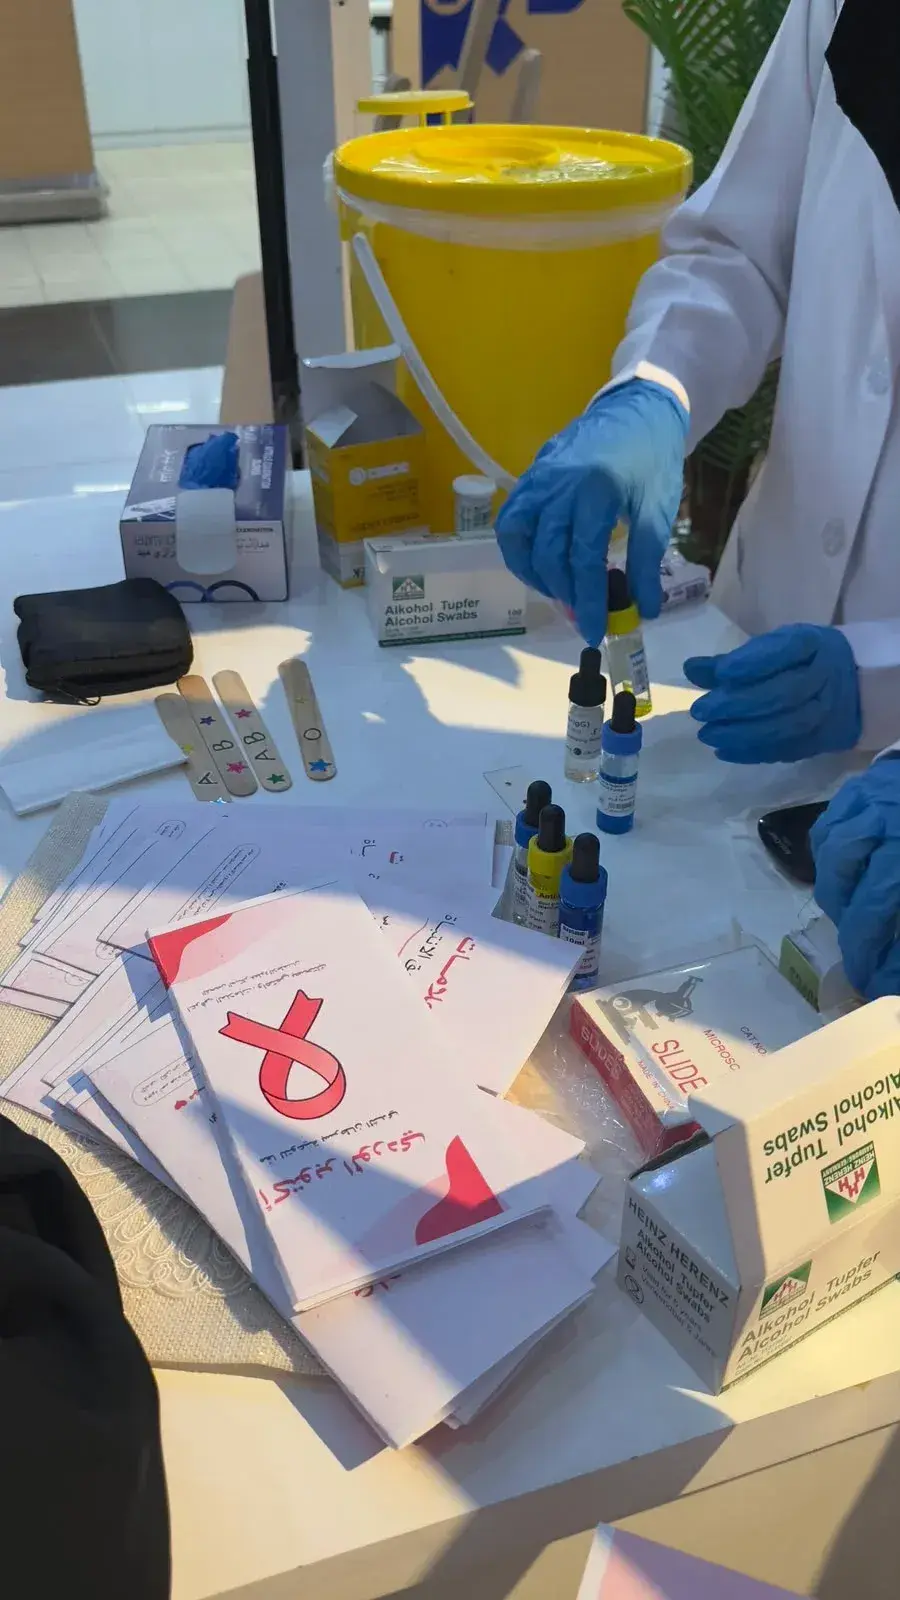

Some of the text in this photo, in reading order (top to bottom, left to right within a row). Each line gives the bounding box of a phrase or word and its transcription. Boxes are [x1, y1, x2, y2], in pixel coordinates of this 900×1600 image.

[385, 598, 480, 616] Alkohol Tupfer
[385, 610, 478, 627] Alcohol Swabs
[212, 739, 234, 752] B
[198, 771, 219, 785] A
[280, 1138, 320, 1160] للتوعية
[321, 1121, 362, 1142] بسرطان
[365, 1109, 399, 1128] الثدي
[763, 1111, 828, 1157] Swabs
[258, 1129, 426, 1213] أكتوبر الوردي
[765, 1138, 828, 1184] Tupfer
[629, 1197, 730, 1309] HEINZ HERENZ
[637, 1229, 675, 1273] Alkohol
[680, 1272, 716, 1313] Tupfer
[636, 1241, 673, 1286] Alcohol
[676, 1281, 710, 1323] Swabs
[740, 1289, 816, 1347] Alkohol
[826, 1250, 881, 1293] Tupfer
[737, 1309, 810, 1362] Alcohol
[815, 1268, 872, 1312] Swabs
